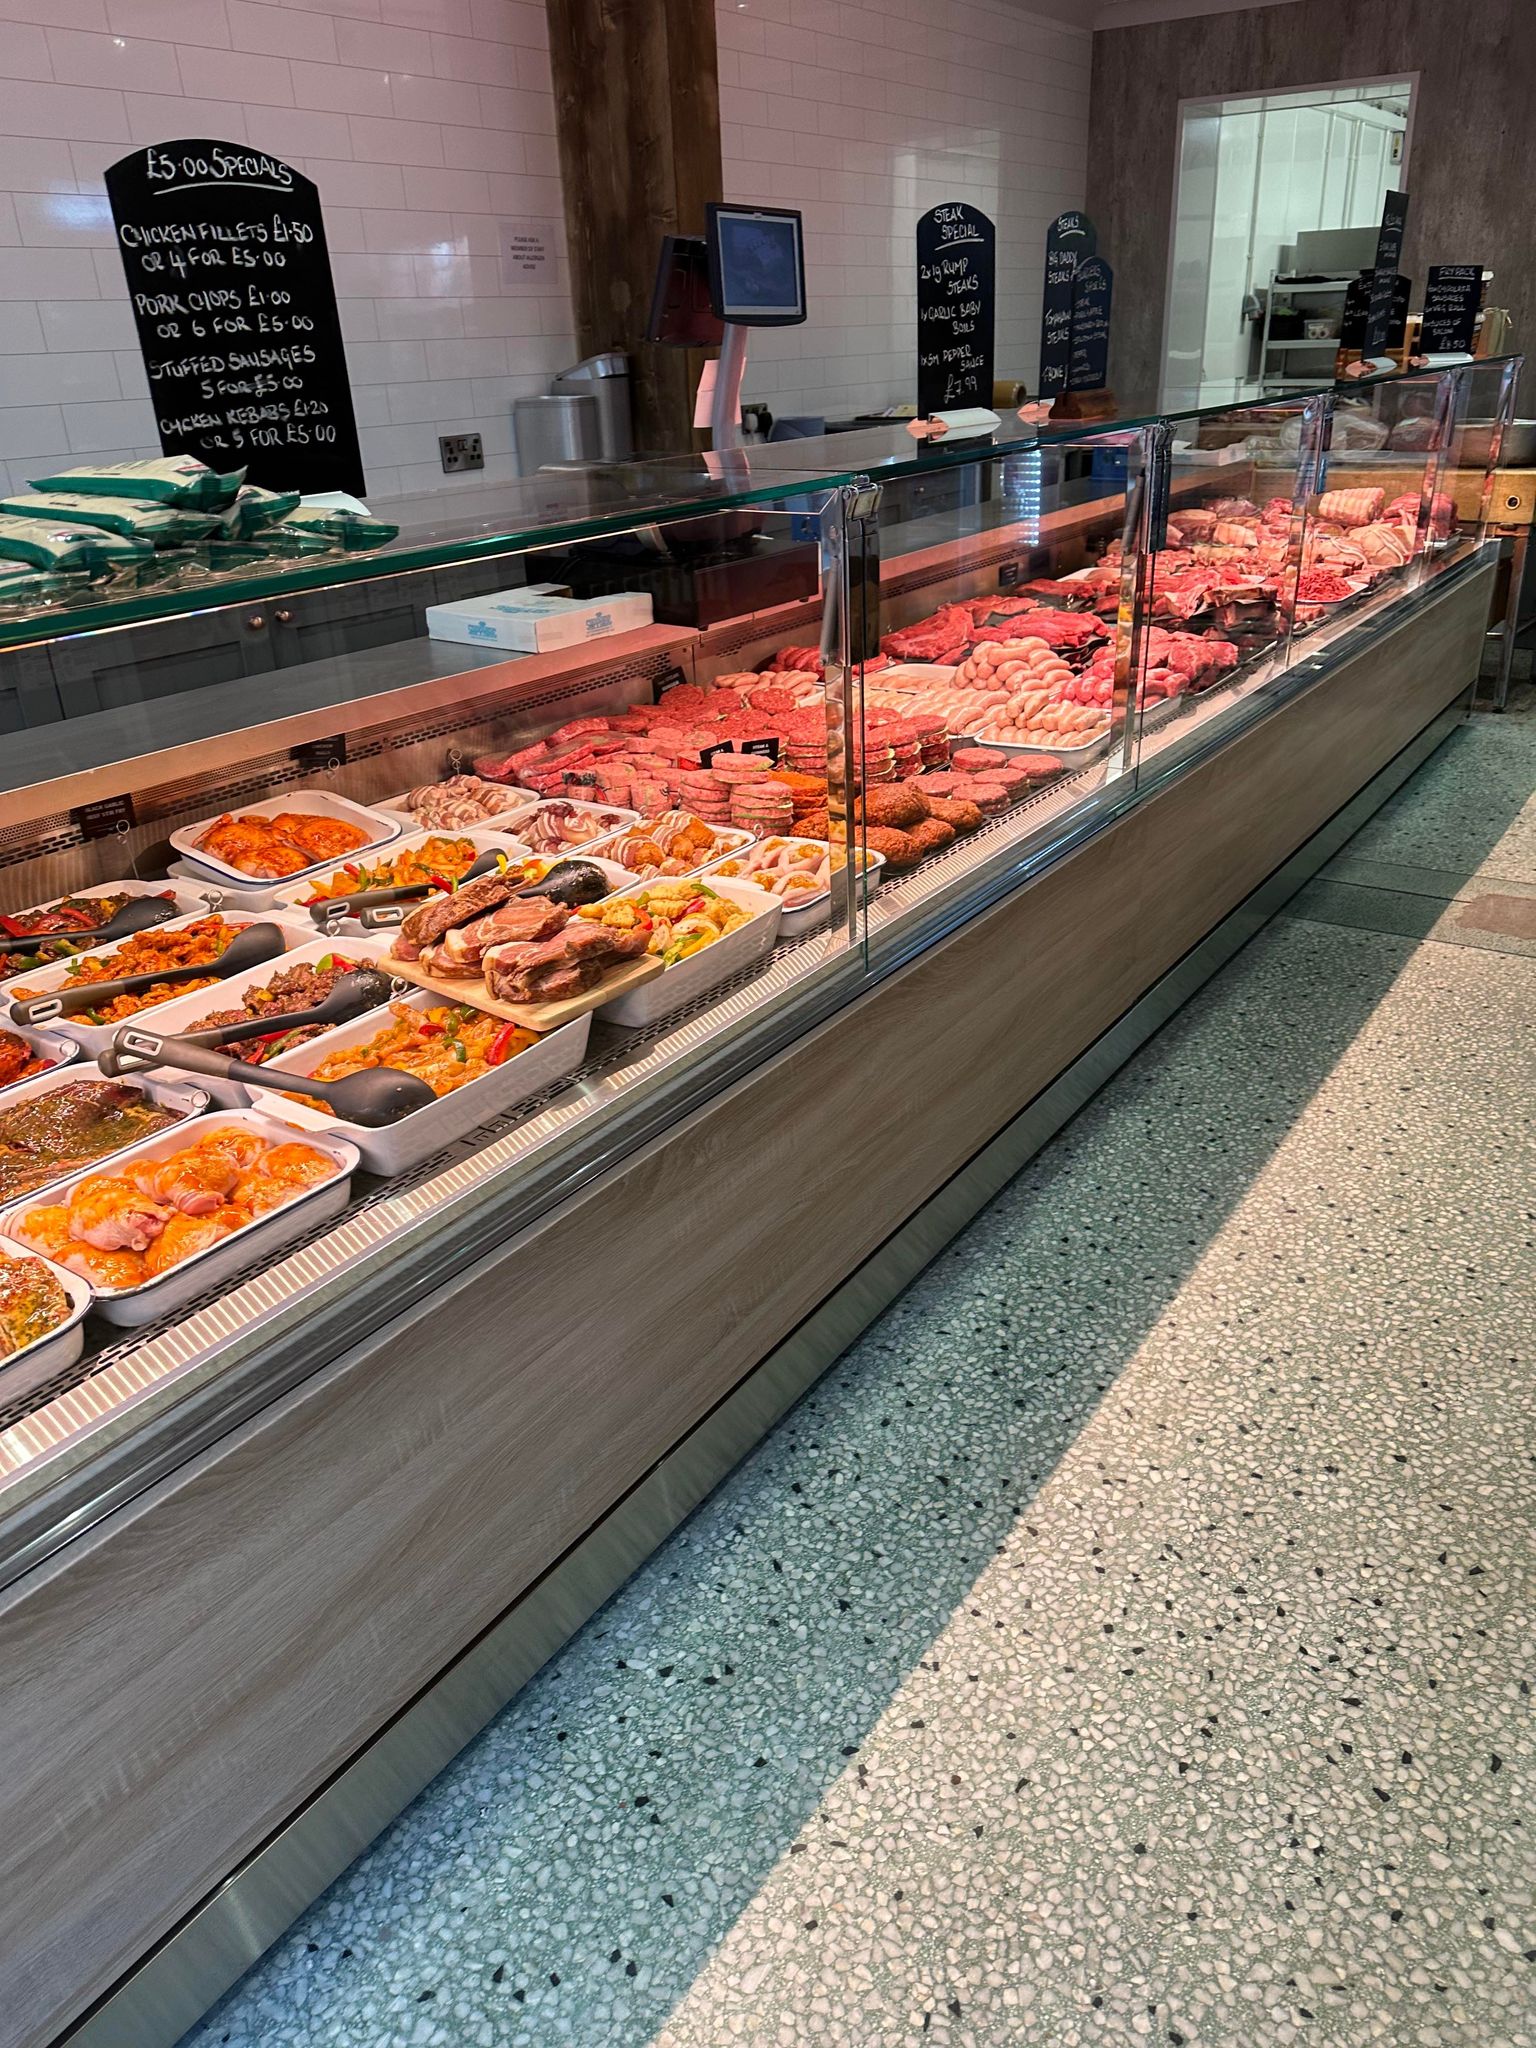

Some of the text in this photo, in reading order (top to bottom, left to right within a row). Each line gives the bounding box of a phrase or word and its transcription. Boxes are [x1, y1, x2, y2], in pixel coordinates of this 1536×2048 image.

[210, 148, 293, 185] SPECIALS
[933, 204, 964, 224] STEAK
[1057, 215, 1079, 232] STEAKS
[121, 223, 197, 247] CHICKEN
[199, 222, 268, 242] FILLETS
[941, 223, 980, 240] SPECIAL
[141, 255, 164, 271] OR
[169, 252, 187, 278] 4
[188, 247, 225, 266] FOR
[941, 257, 969, 276] RUMP
[946, 274, 979, 296] STEAKS
[1048, 270, 1070, 285] STEAKS
[135, 293, 189, 316] PORK
[189, 290, 241, 312] CHOPS
[928, 305, 957, 321] GARLIC
[960, 299, 982, 318] BABY
[157, 322, 181, 338] OR
[192, 319, 206, 336] 6
[213, 317, 252, 334] FOR
[1047, 327, 1070, 345] STEAKS
[150, 345, 316, 379] STUFFED SAUSAGES
[943, 344, 973, 362] PEPPER
[960, 354, 985, 372] SAUCE
[201, 379, 214, 399] 5
[217, 380, 252, 395] FOR
[160, 412, 222, 436] CHICKEN
[226, 403, 290, 425] KEBABS
[200, 435, 229, 448] OR
[232, 428, 244, 448] 5
[250, 428, 284, 446] FOR
